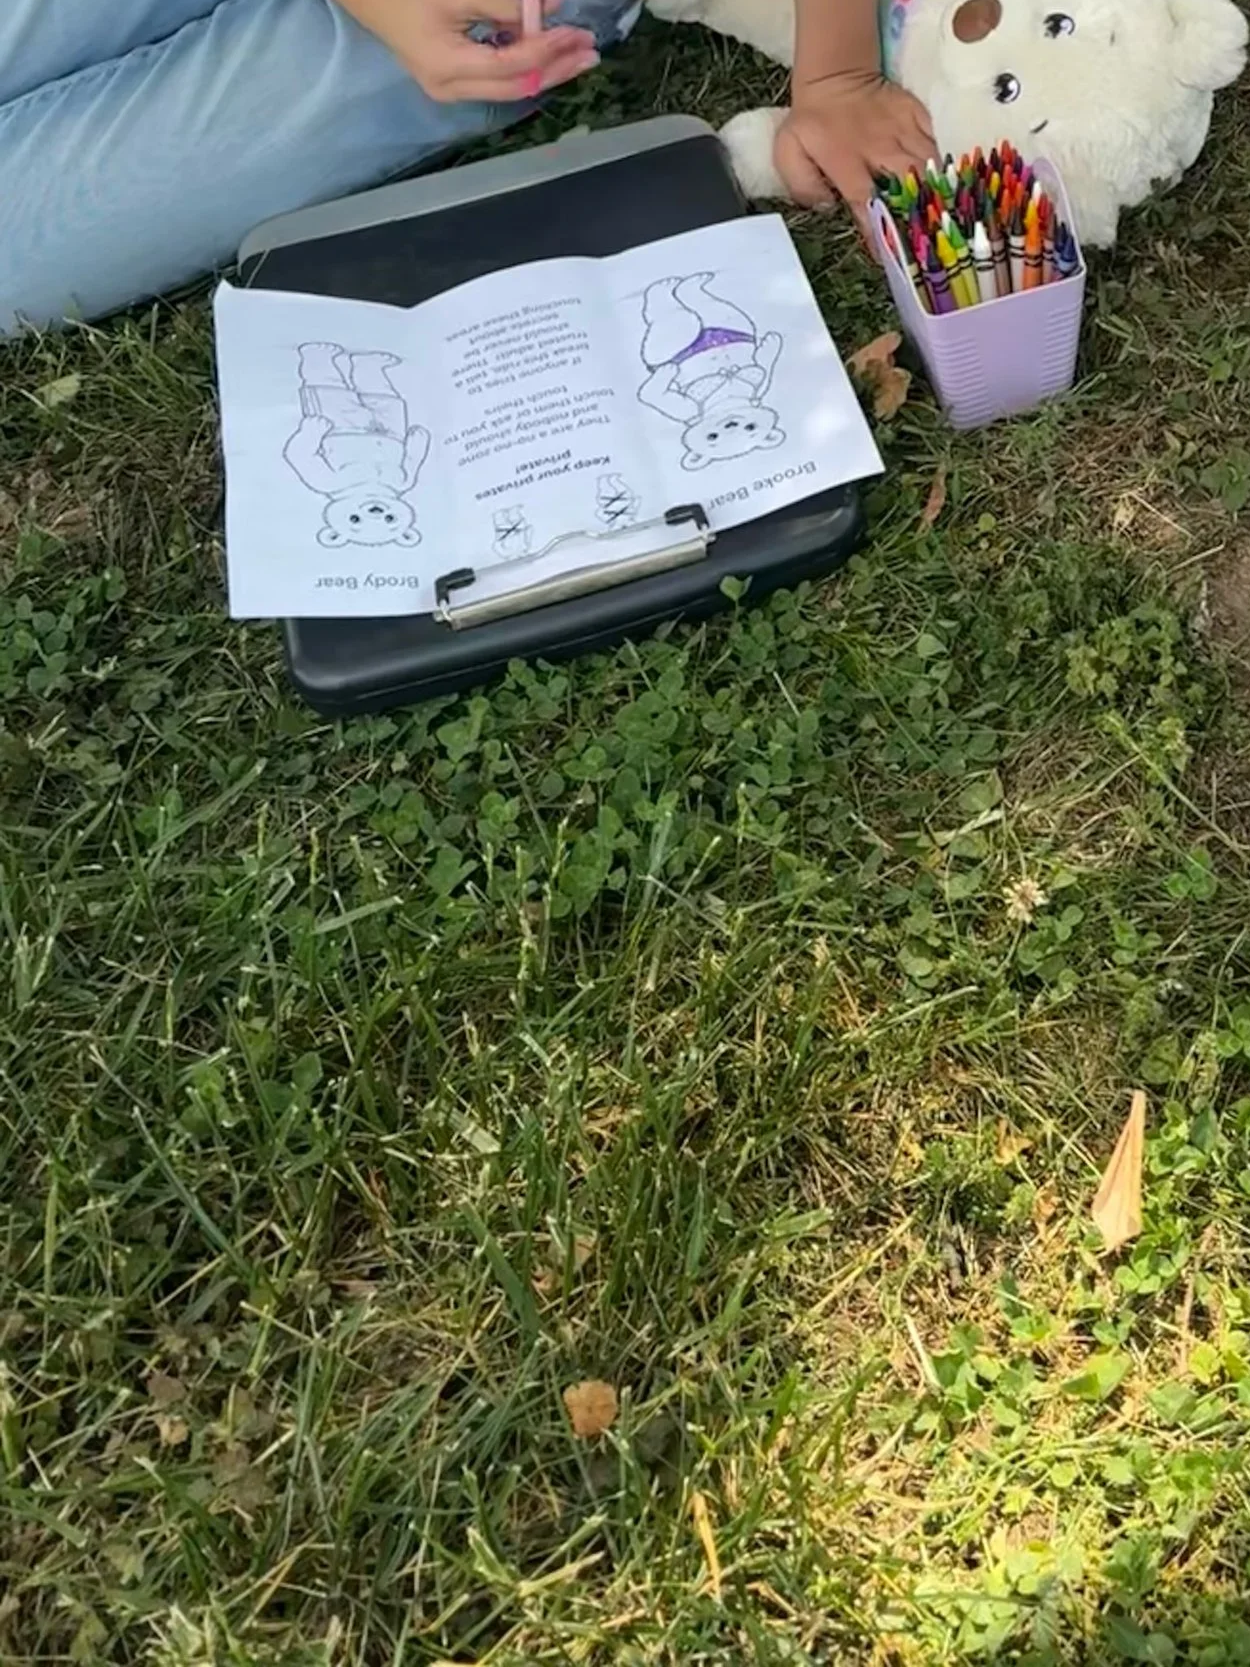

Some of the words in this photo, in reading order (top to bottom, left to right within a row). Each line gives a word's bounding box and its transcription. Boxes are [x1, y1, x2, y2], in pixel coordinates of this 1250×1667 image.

[573, 387, 613, 403] touch
[571, 403, 598, 416] and
[550, 423, 573, 434] are
[576, 414, 609, 427] They
[463, 429, 512, 451] should
[573, 455, 610, 470] Keep
[536, 463, 570, 481] your
[751, 462, 816, 491] Brooke
[475, 475, 533, 501] privates
[705, 487, 749, 510] Bear
[314, 576, 357, 591] Bear
[362, 571, 419, 590] Brody
